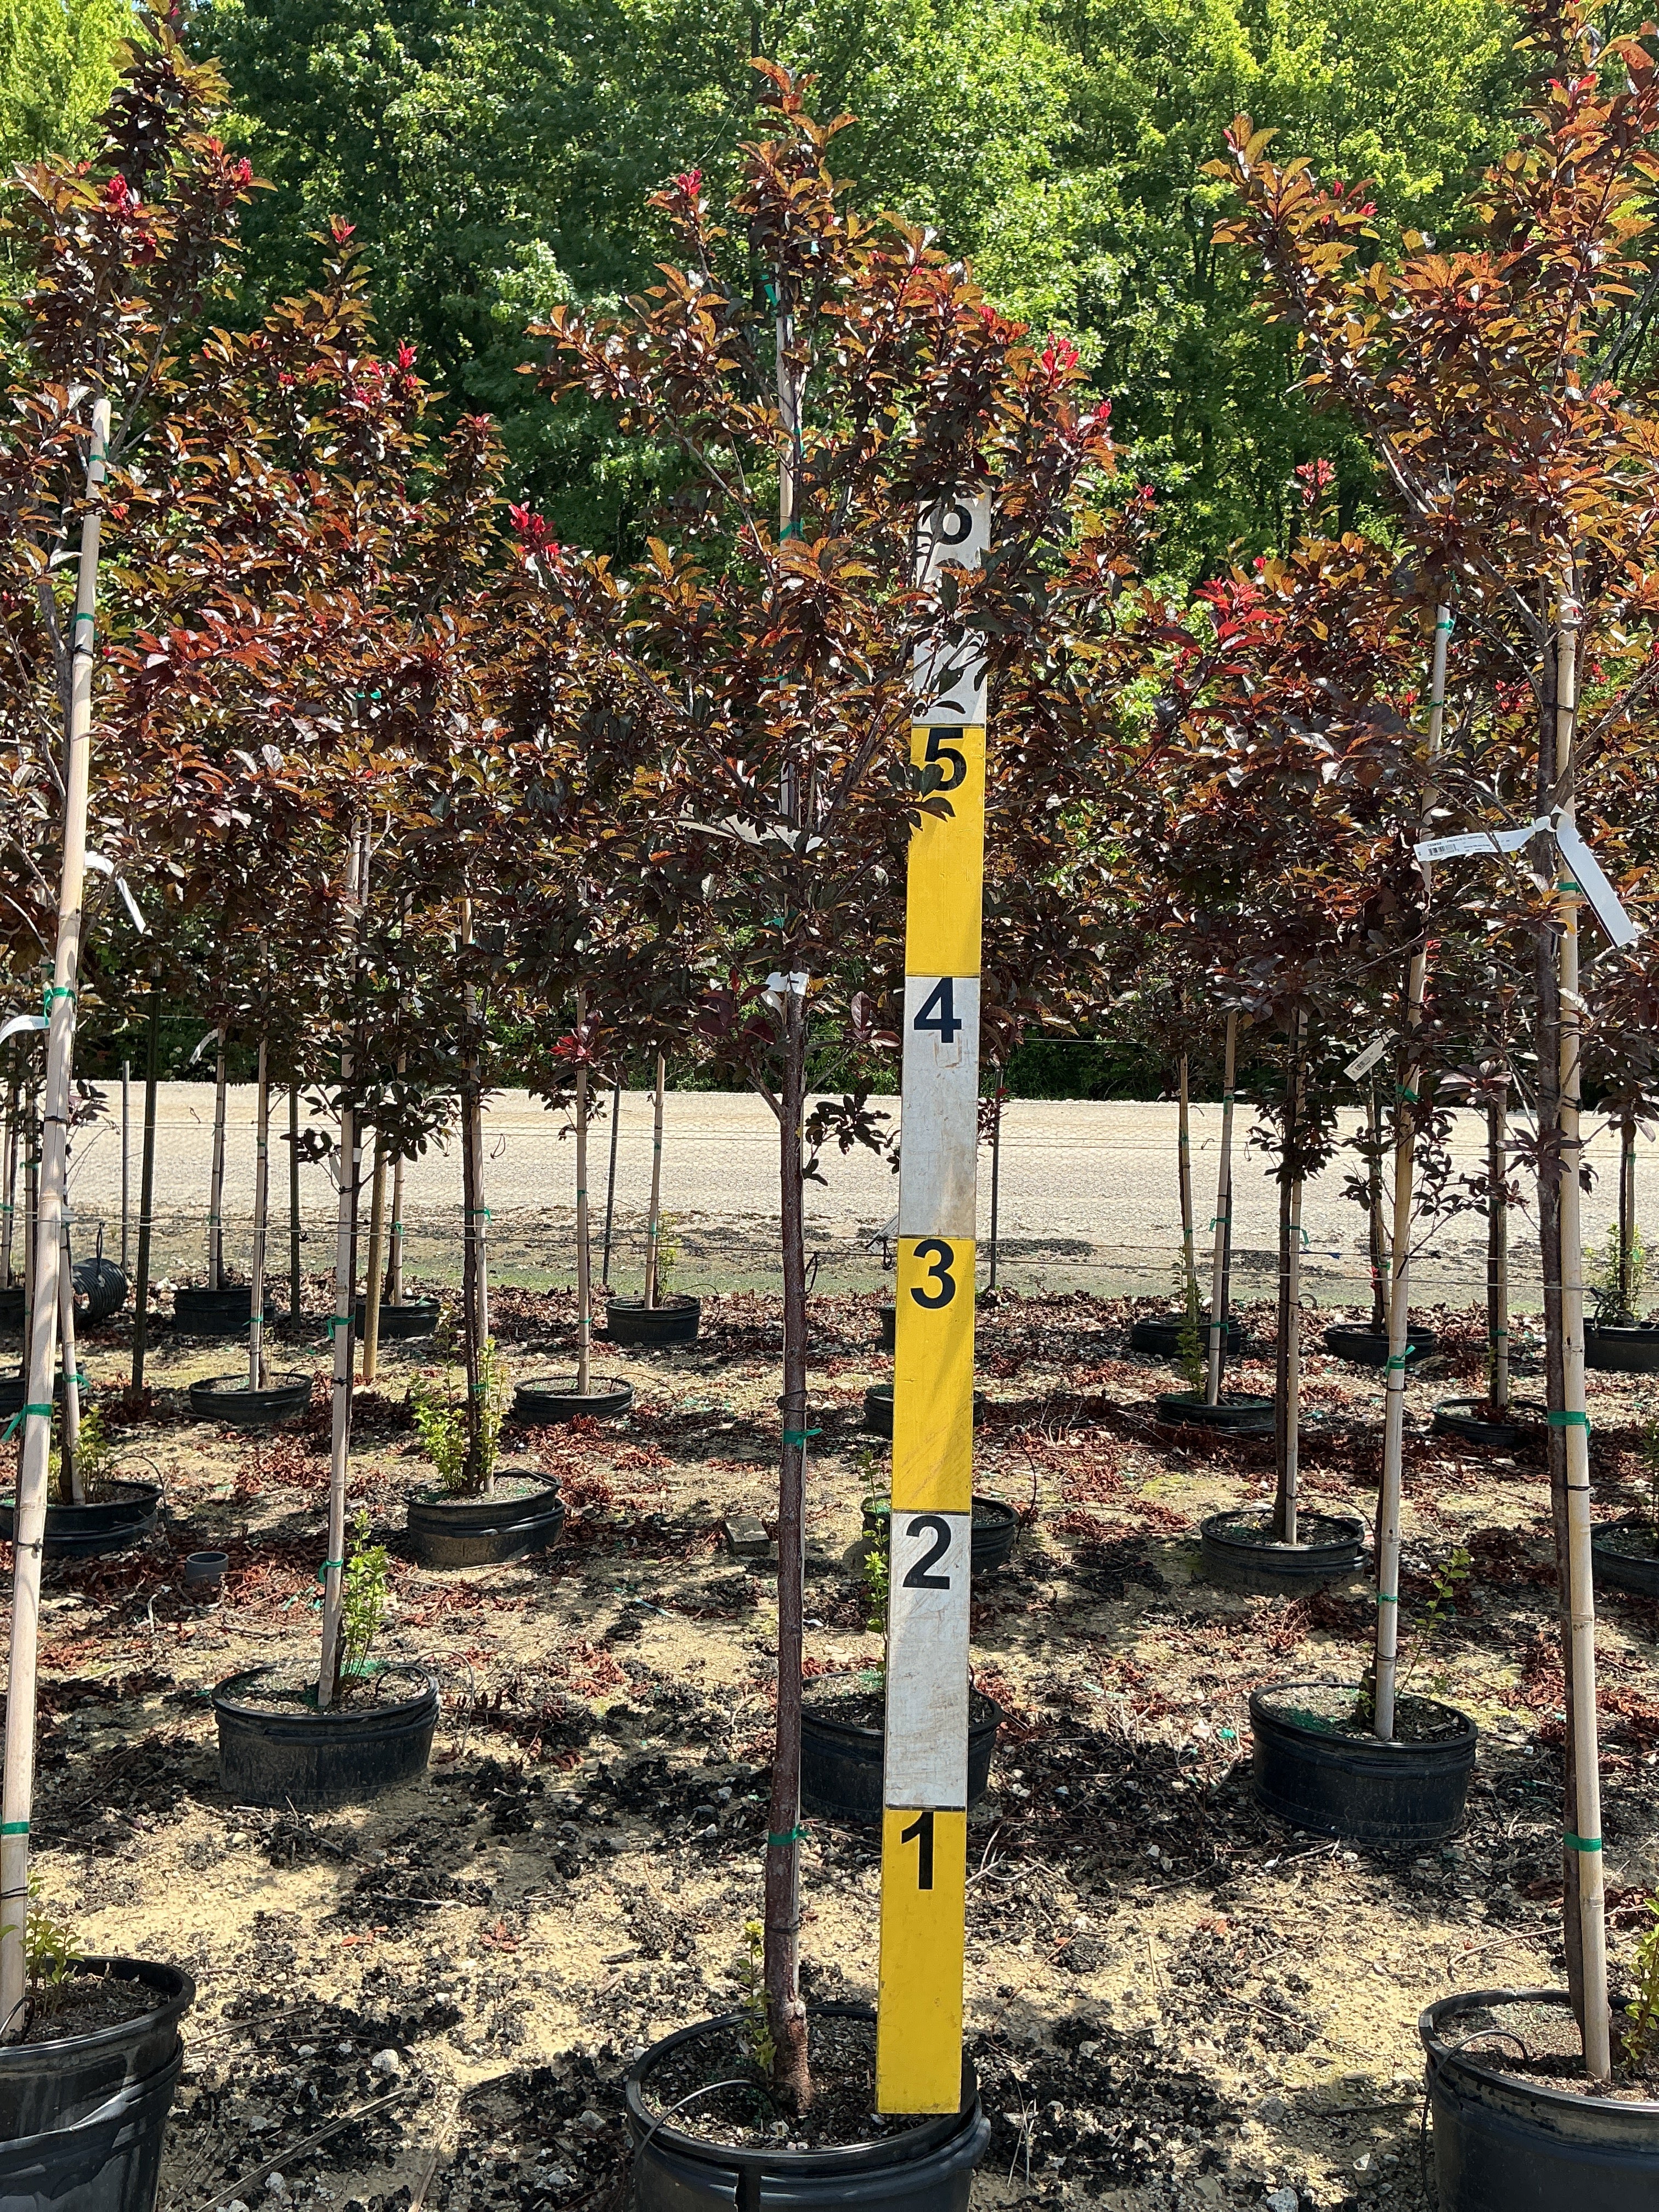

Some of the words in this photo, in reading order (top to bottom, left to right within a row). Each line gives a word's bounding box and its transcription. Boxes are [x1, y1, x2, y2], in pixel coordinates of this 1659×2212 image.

[924, 727, 967, 791] 5
[913, 977, 962, 1043] 4
[911, 1239, 956, 1309] 3
[902, 1515, 952, 1590] 2
[900, 1811, 934, 1890] 1
